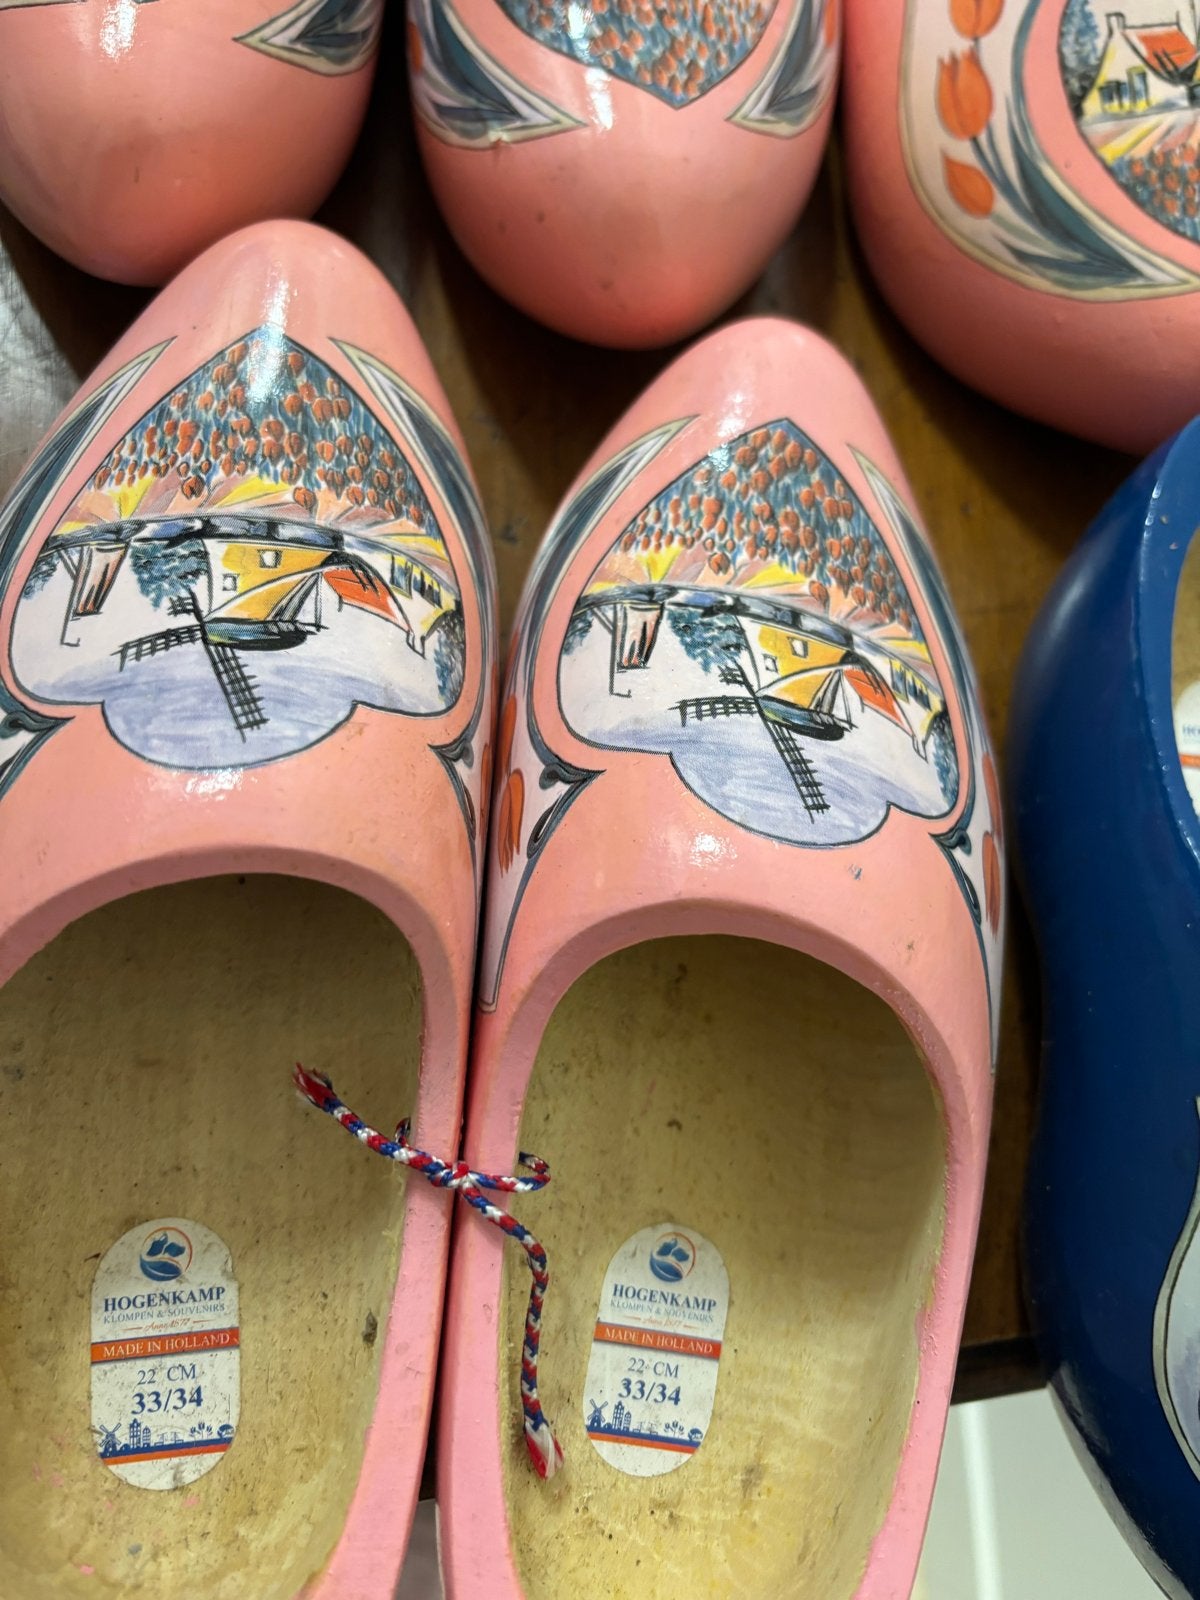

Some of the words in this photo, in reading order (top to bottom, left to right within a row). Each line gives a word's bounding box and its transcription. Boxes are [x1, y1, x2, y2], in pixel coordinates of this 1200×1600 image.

[104, 1287, 226, 1312] HOGENKAMP
[610, 1300, 653, 1313] KLOMPEN
[613, 1283, 717, 1312] HOGENKAMP
[103, 1310, 154, 1324] KLOMPEN
[157, 1310, 165, 1319] &
[168, 1303, 225, 1317] SOUVENIRS
[103, 1343, 143, 1358] MADE
[148, 1340, 161, 1352] IN
[165, 1332, 230, 1350] HOLLAND
[605, 1327, 639, 1342] MADE
[641, 1333, 654, 1345] IN
[656, 1336, 713, 1354] HOLLAND
[137, 1369, 156, 1385] 22
[167, 1364, 196, 1381] CM
[628, 1357, 645, 1374] 22
[653, 1361, 679, 1378] CM
[131, 1385, 203, 1415] 33/34
[618, 1377, 681, 1406] 33/34
